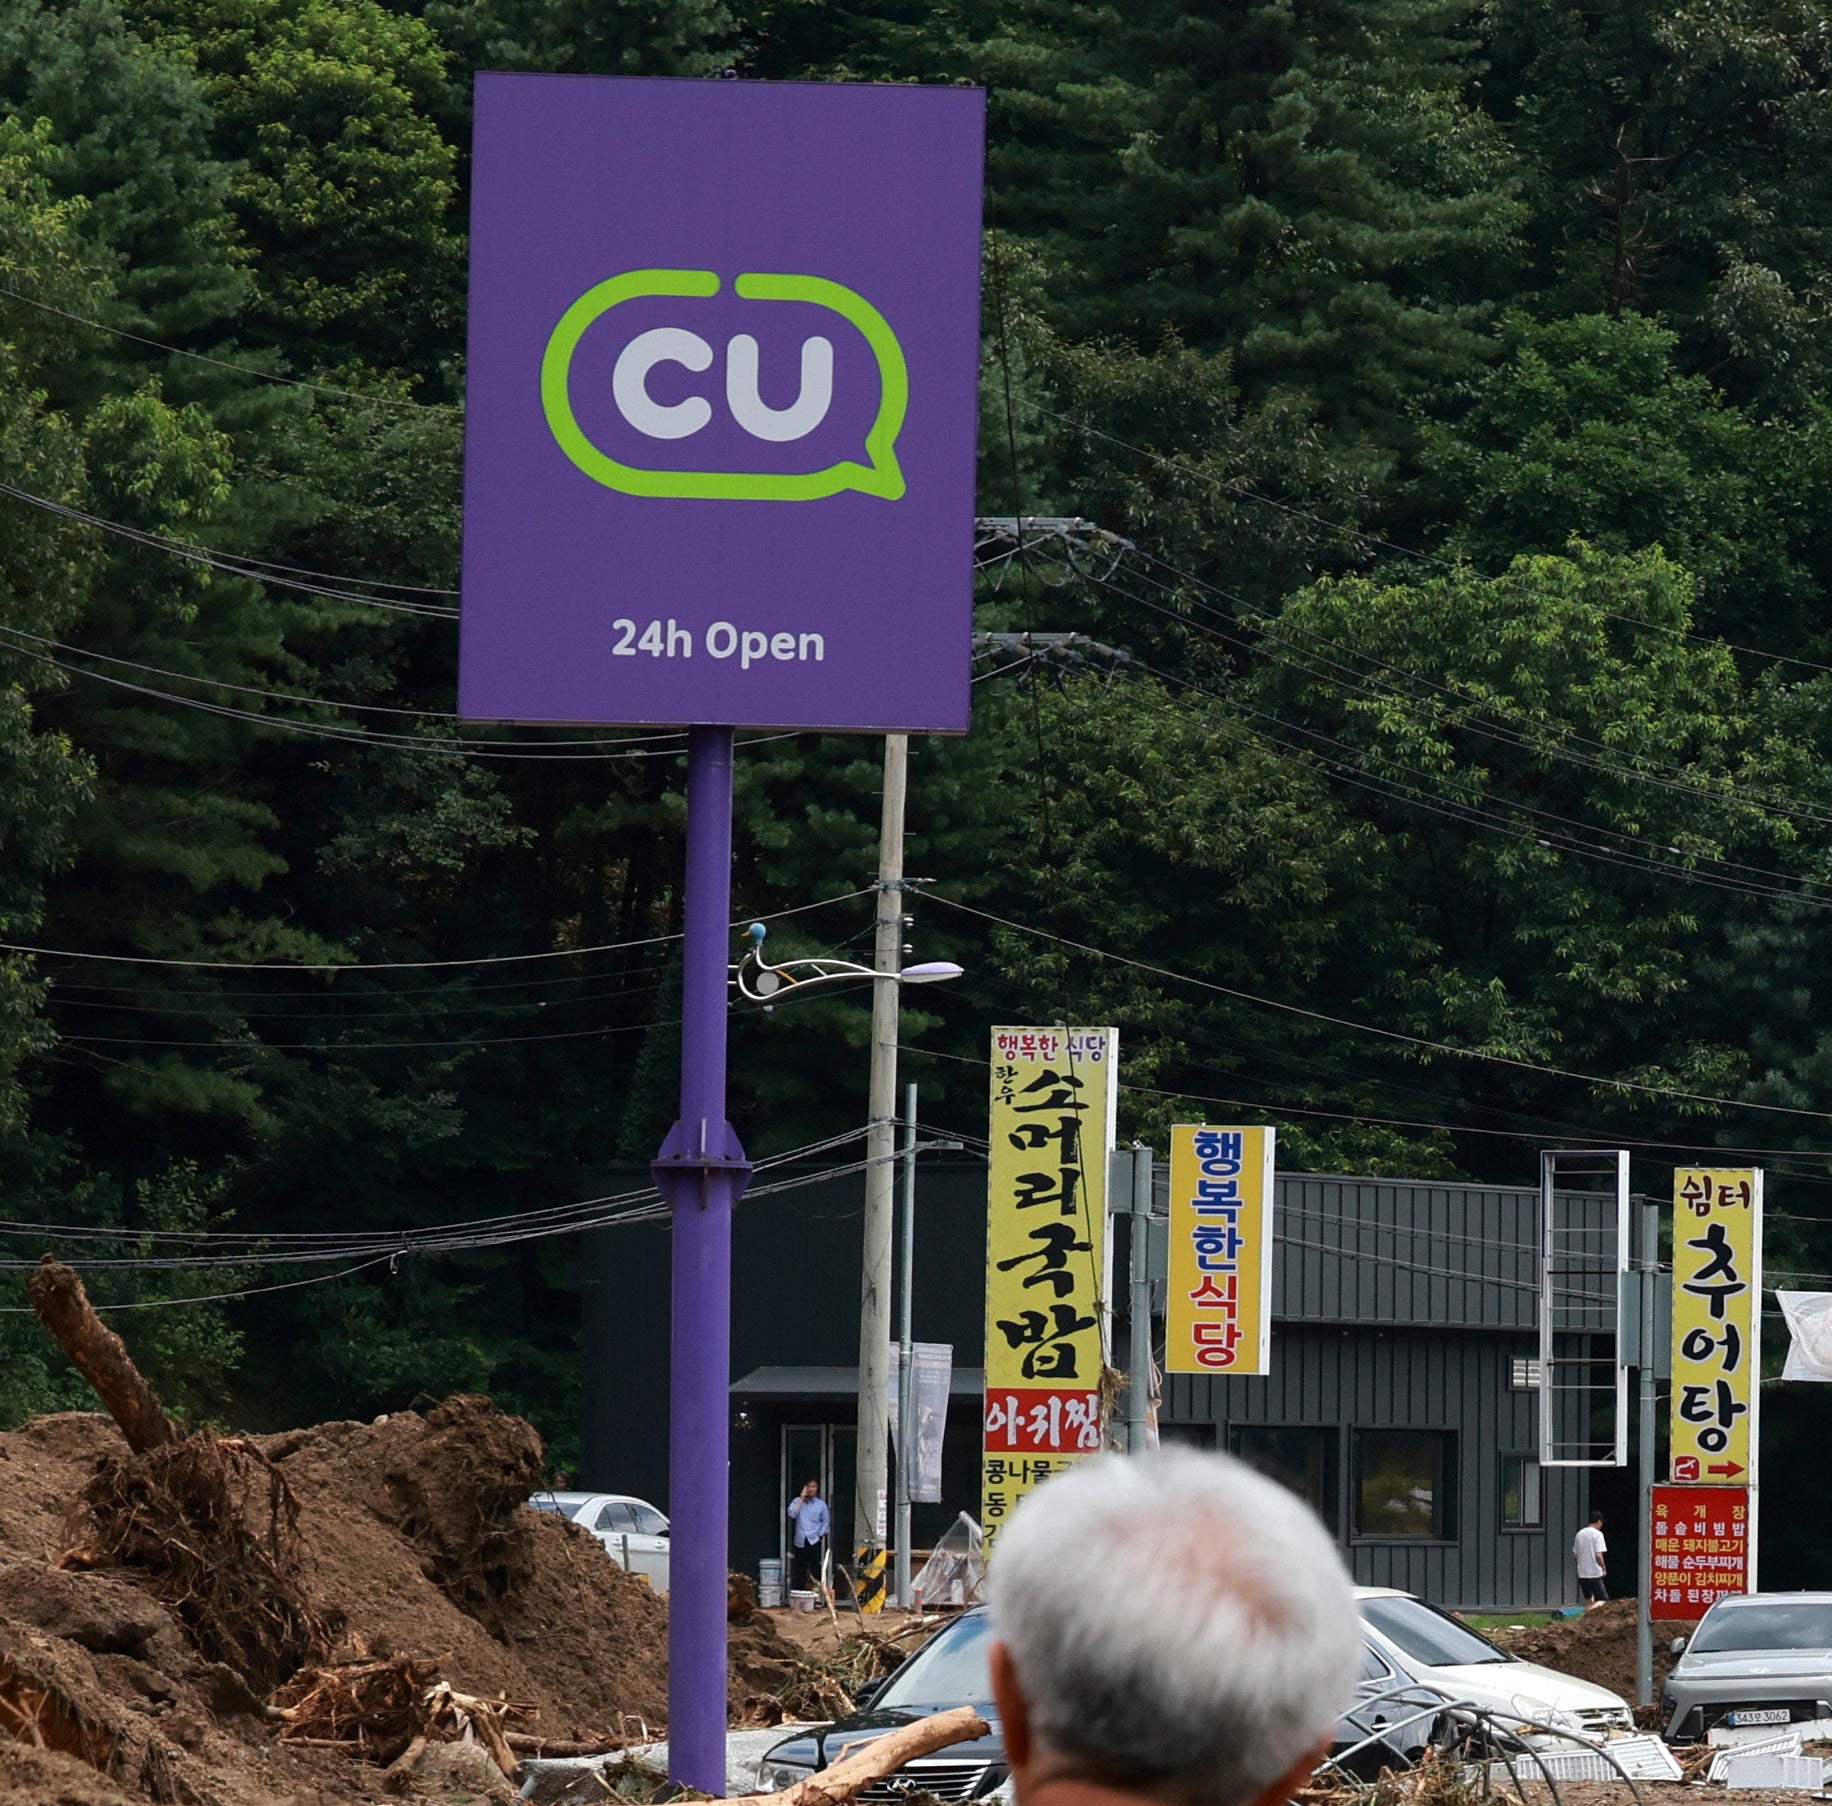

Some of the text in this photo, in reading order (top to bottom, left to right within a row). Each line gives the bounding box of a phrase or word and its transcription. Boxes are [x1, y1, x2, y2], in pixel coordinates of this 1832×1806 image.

[612, 326, 834, 442] CU
[611, 618, 825, 670] 24h Open
[997, 1033, 1106, 1062] 행복한 식당
[1679, 1174, 1751, 1217] 쉼터
[996, 1069, 1097, 1380] 소머리국밥
[1680, 1223, 1748, 1453] 추어탕
[1655, 1538, 1744, 1554] 매운 돼지불고기
[1655, 1555, 1744, 1570] 해물 순두부찌개
[1694, 1572, 1743, 1587] 김치찌개
